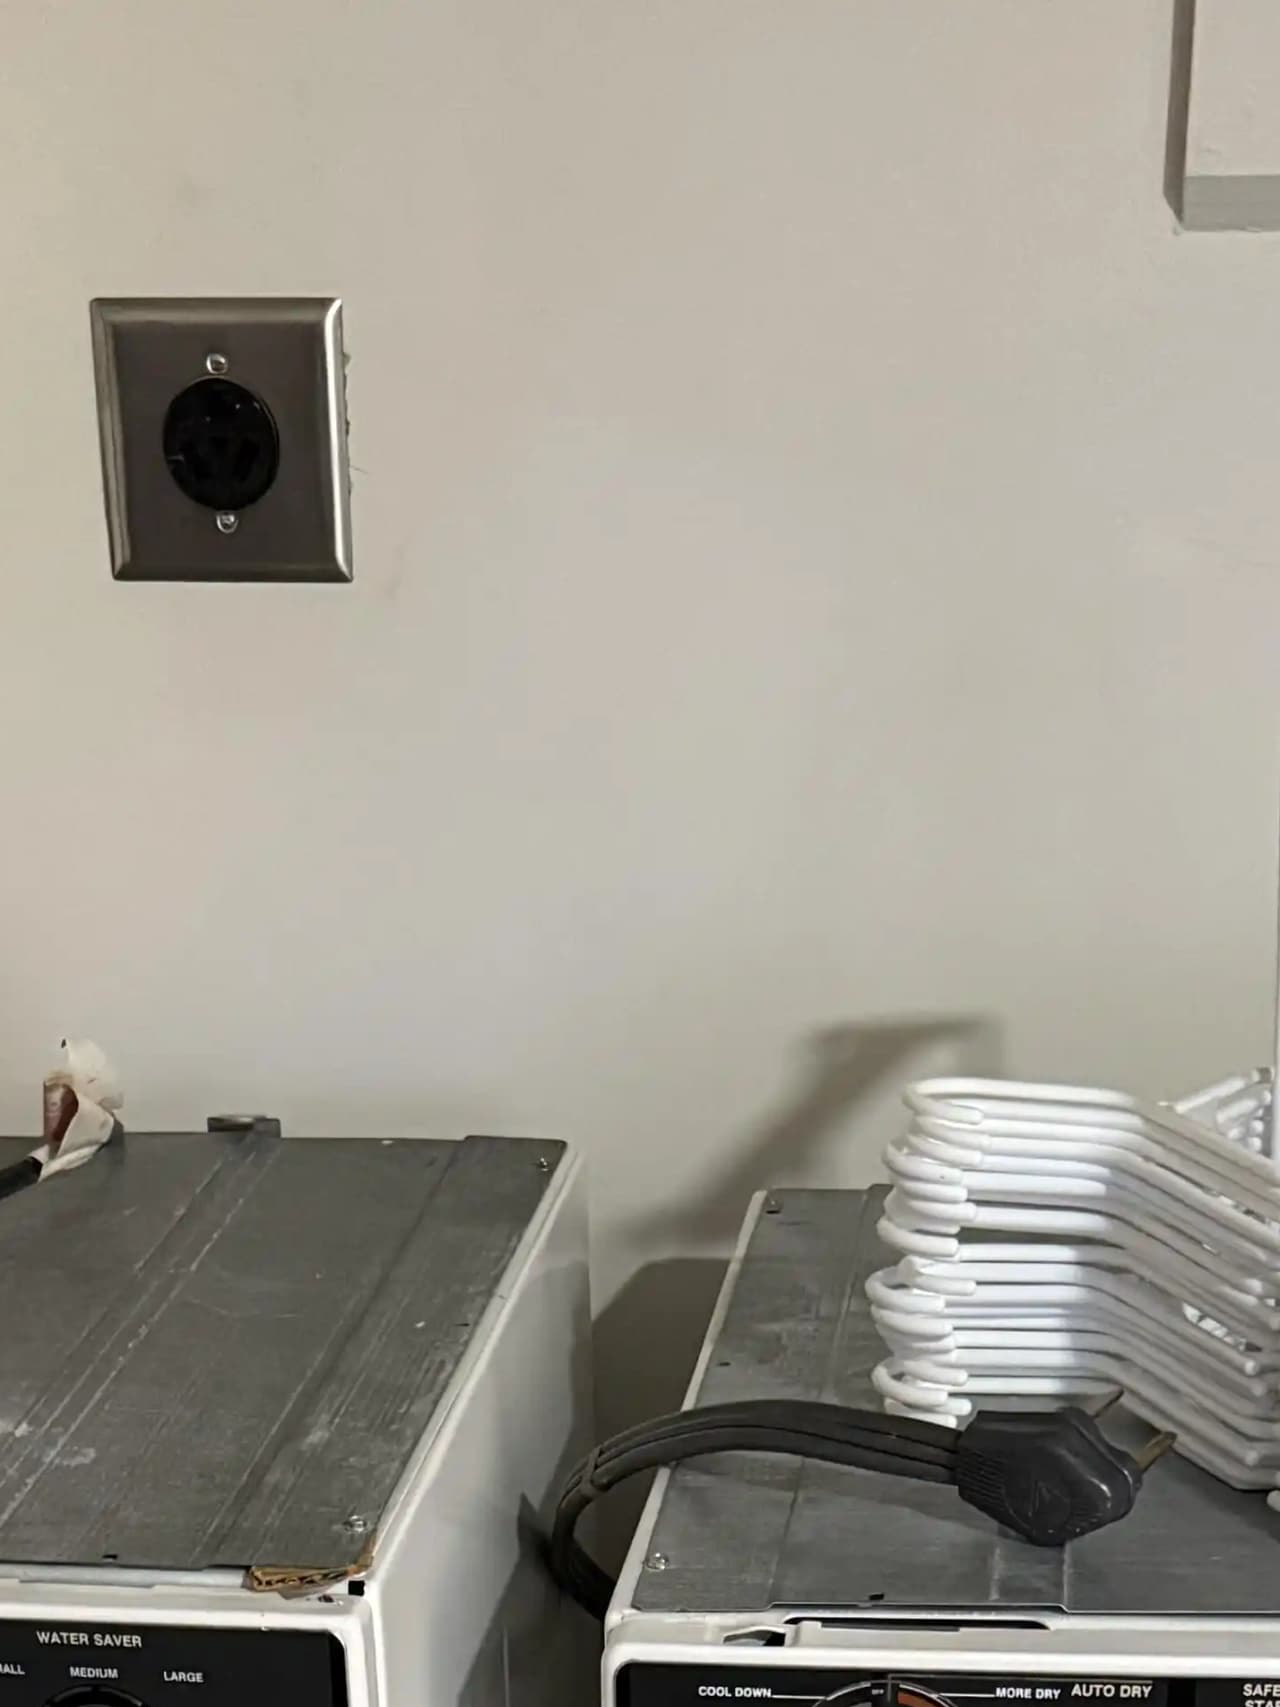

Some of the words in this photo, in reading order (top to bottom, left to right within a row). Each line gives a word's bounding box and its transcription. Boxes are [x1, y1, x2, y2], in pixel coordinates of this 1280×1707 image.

[37, 1632, 89, 1646] WATER
[94, 1634, 142, 1648] SAVER
[70, 1667, 118, 1679] MEDIUM
[164, 1671, 203, 1683] LARGE
[698, 1686, 732, 1697] COOL
[735, 1688, 771, 1698] DOWN
[996, 1687, 1032, 1698] MORE
[1036, 1688, 1060, 1699] DRY
[1072, 1684, 1115, 1697] AUTO
[1120, 1685, 1152, 1698] DRY
